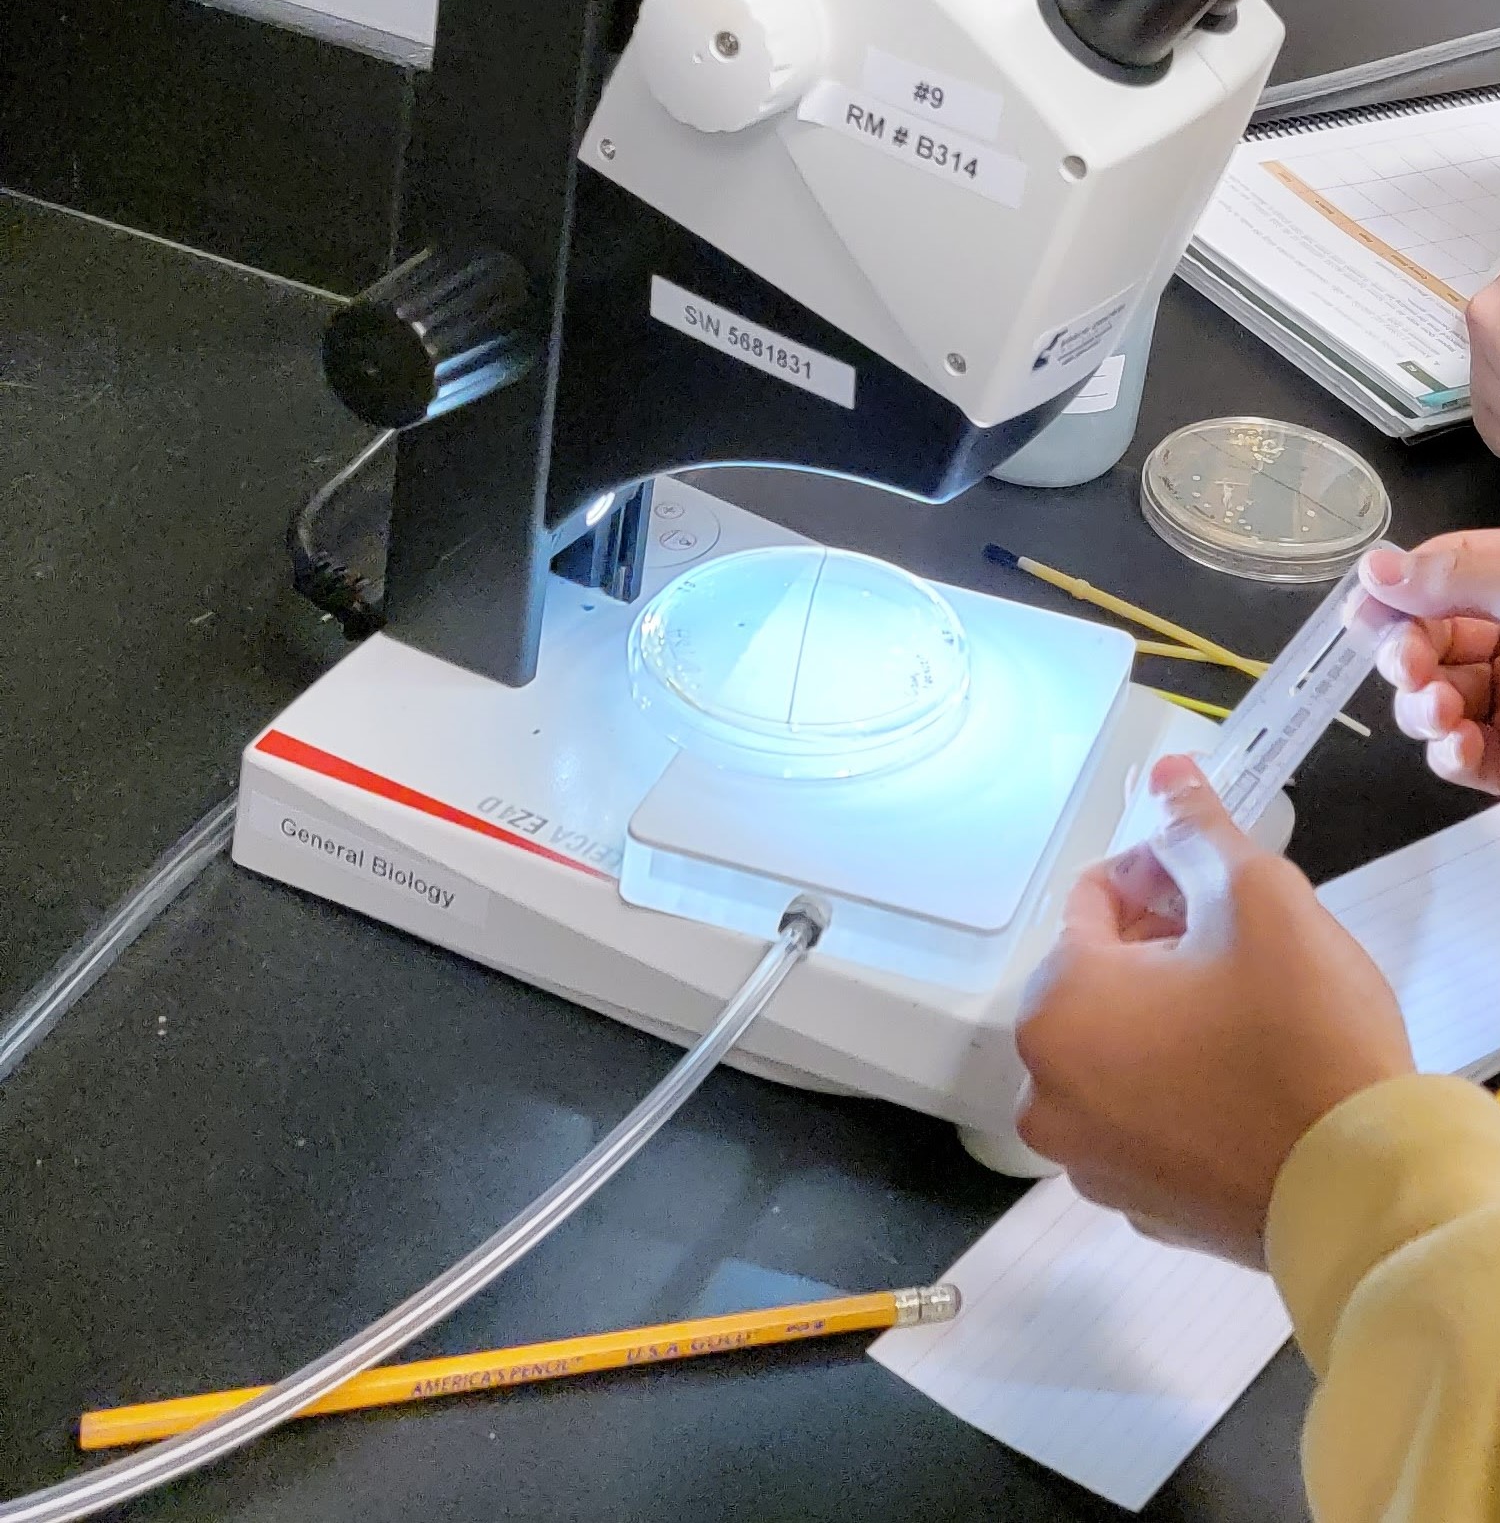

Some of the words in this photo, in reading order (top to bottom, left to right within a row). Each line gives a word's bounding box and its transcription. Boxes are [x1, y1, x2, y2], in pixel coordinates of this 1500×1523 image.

[913, 81, 944, 109] #9
[846, 103, 885, 139] RM
[893, 126, 909, 148] #
[916, 134, 978, 179] B314
[727, 326, 812, 380] 5681831
[280, 818, 365, 868] General
[371, 855, 456, 909] Biology
